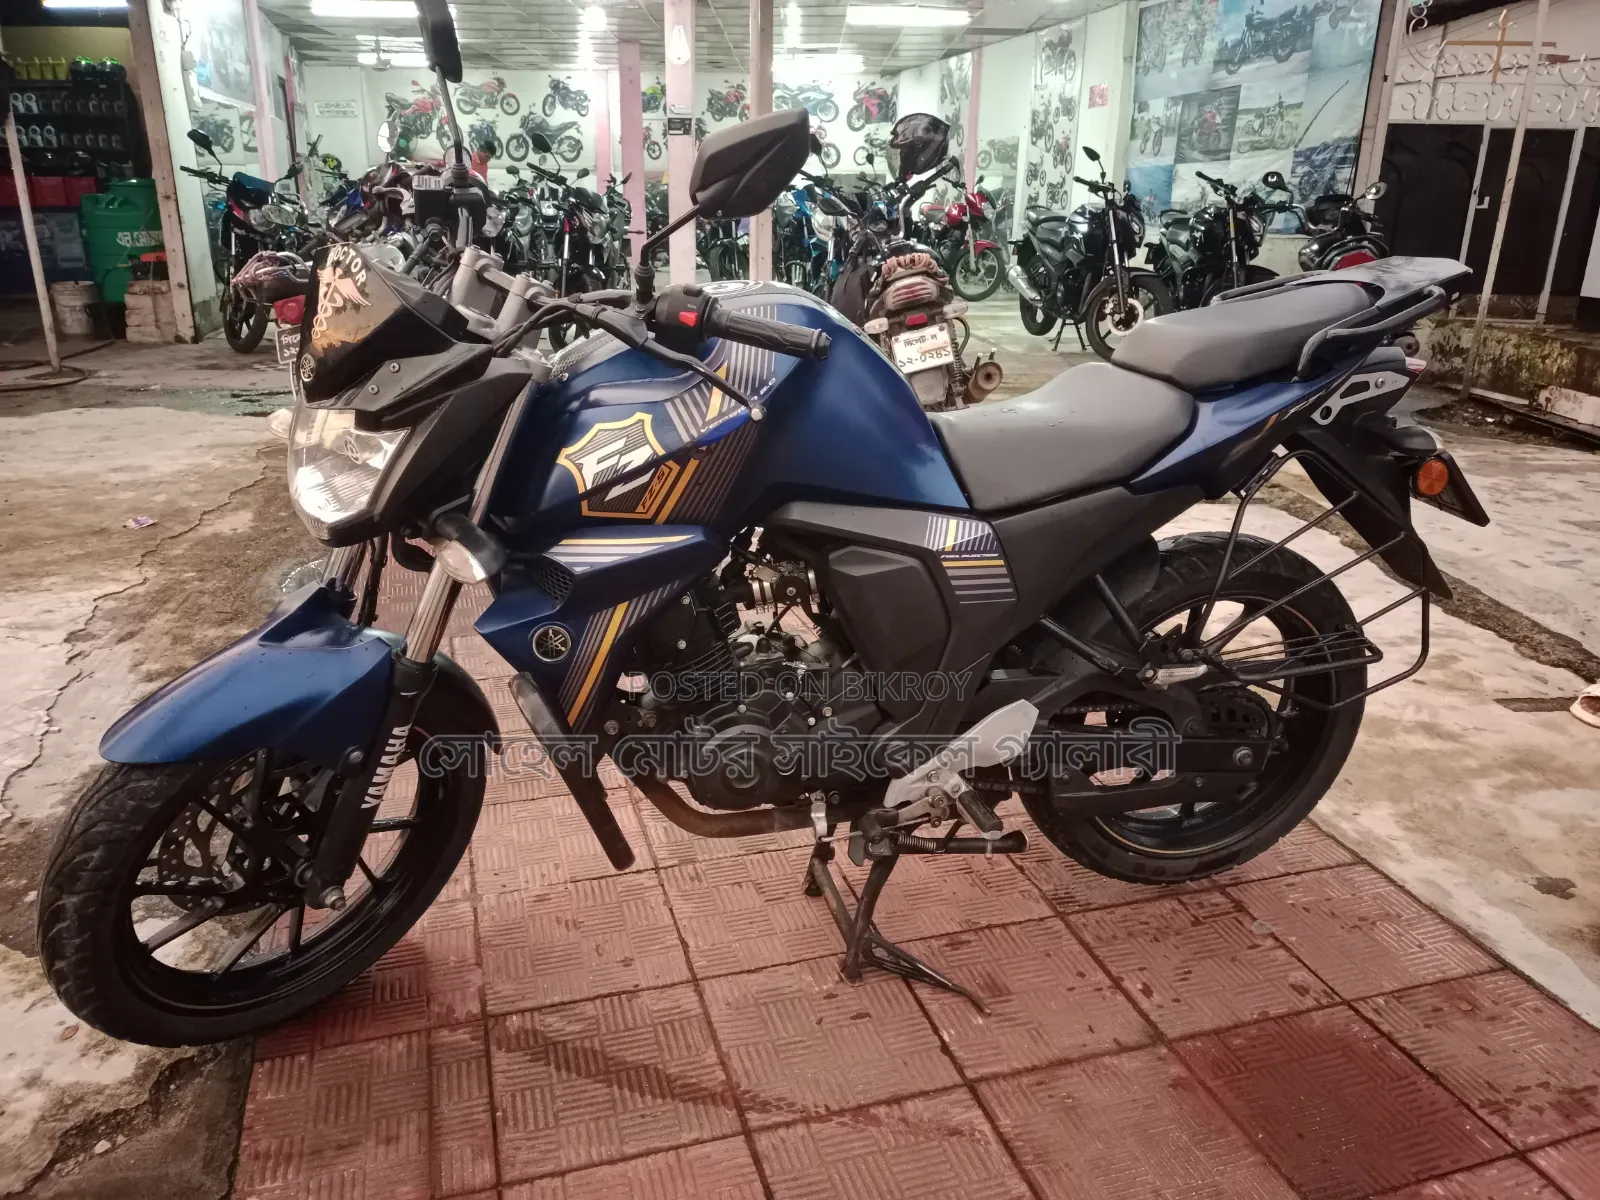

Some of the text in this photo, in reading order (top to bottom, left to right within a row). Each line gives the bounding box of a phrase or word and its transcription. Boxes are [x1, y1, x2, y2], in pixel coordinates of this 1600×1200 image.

[326, 245, 367, 287] DOCTOR
[897, 347, 951, 368] ১২-০২৪১
[360, 722, 413, 809] YAMAHA
